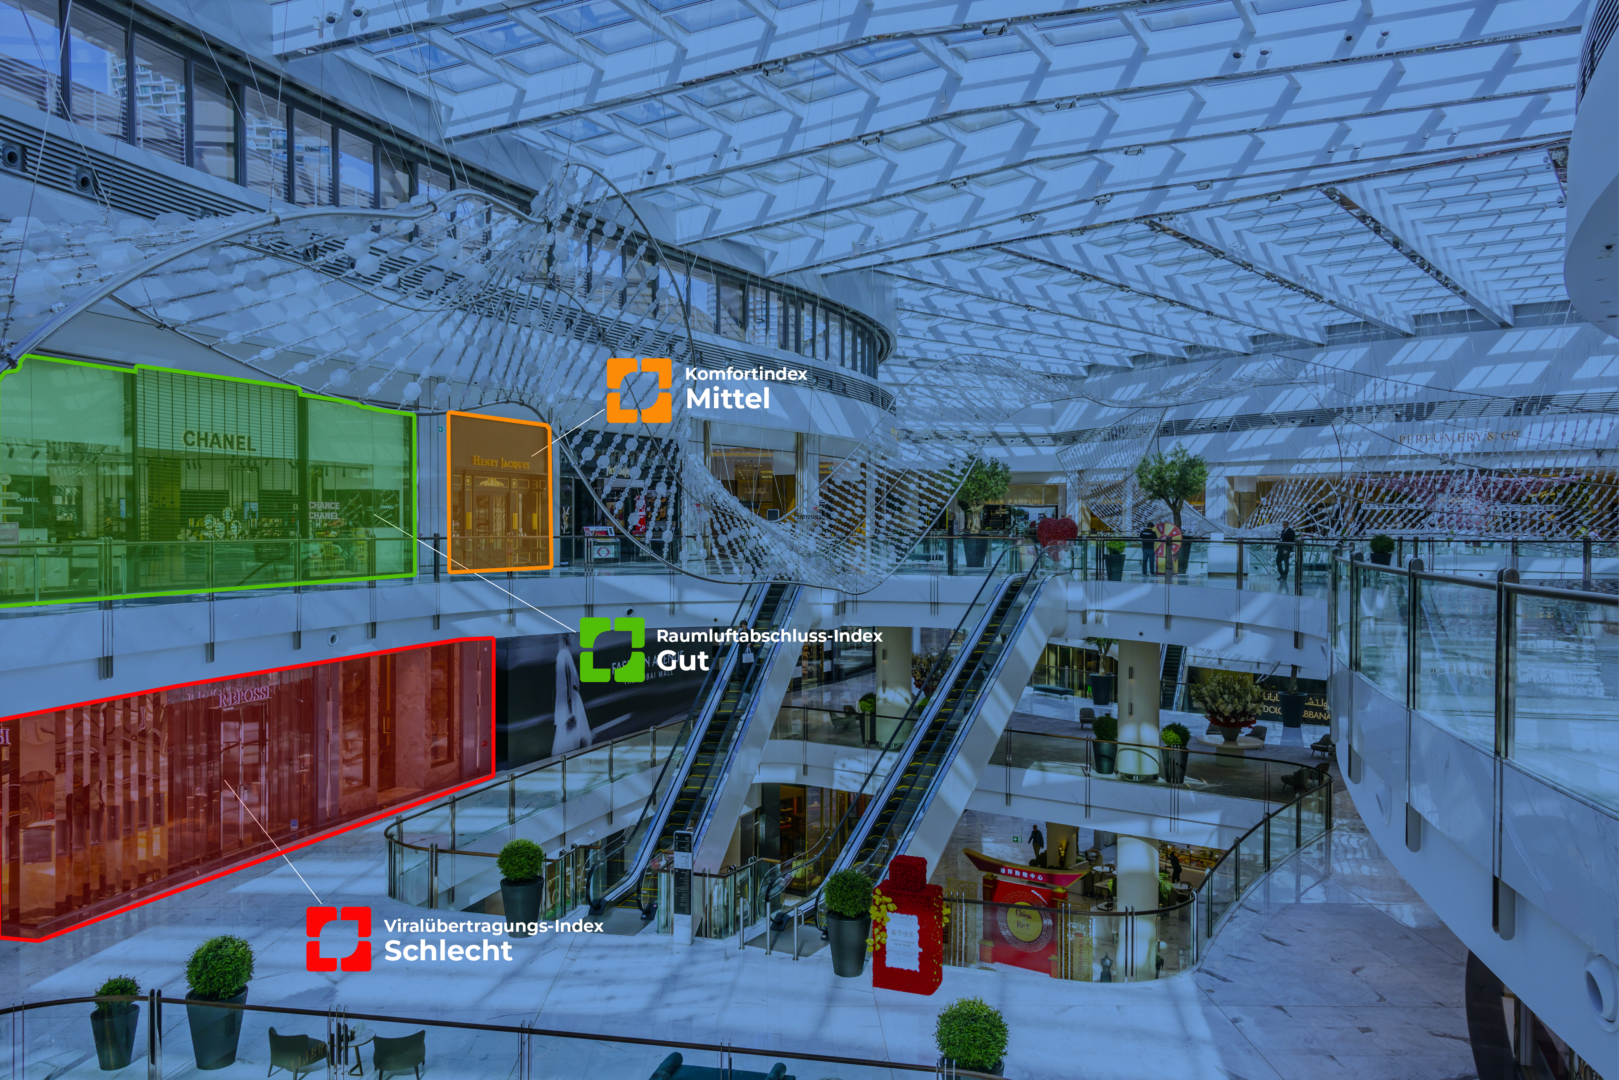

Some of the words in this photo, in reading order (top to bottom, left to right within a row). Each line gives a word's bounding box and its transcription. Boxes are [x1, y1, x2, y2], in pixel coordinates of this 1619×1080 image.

[183, 430, 257, 451] CHANEL
[1399, 432, 1484, 444] PERFUMERY
[1486, 431, 1496, 442] &
[308, 501, 340, 510] CHANCE
[308, 511, 341, 520] CHANEL
[219, 685, 270, 708] REPOSSI
